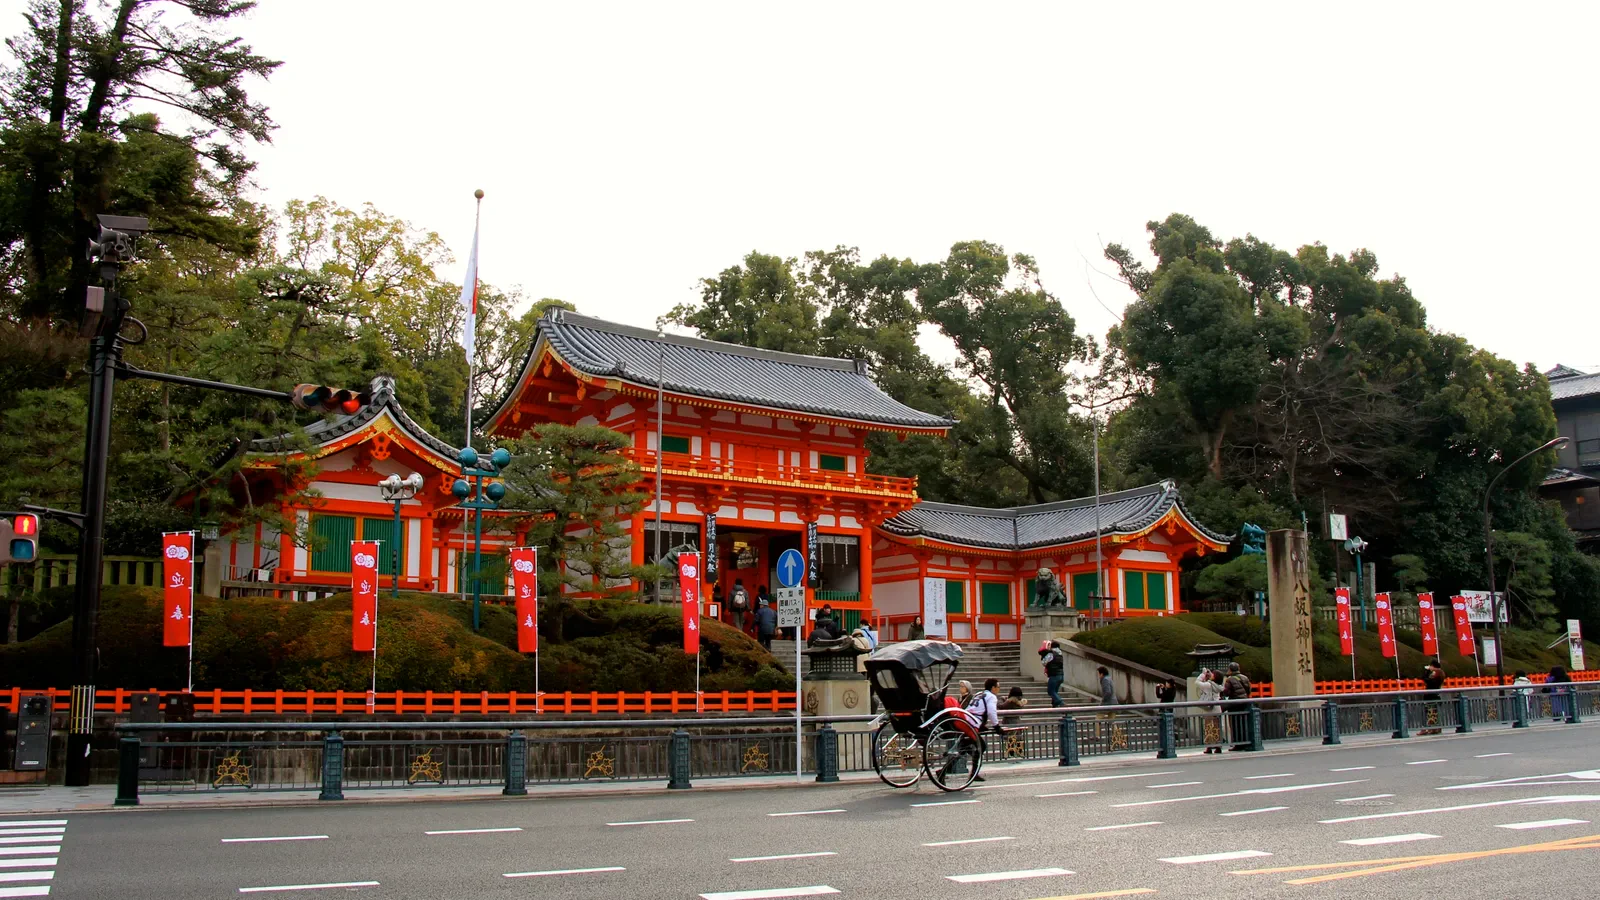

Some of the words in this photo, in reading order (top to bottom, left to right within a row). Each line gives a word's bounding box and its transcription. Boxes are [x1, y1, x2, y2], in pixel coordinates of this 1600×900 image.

[707, 543, 716, 573] 月次祭
[809, 550, 817, 581] 成人祭
[170, 572, 184, 620] 迎春
[359, 580, 371, 626] 迎春
[520, 584, 533, 628] 迎春
[685, 588, 697, 631] 迎春
